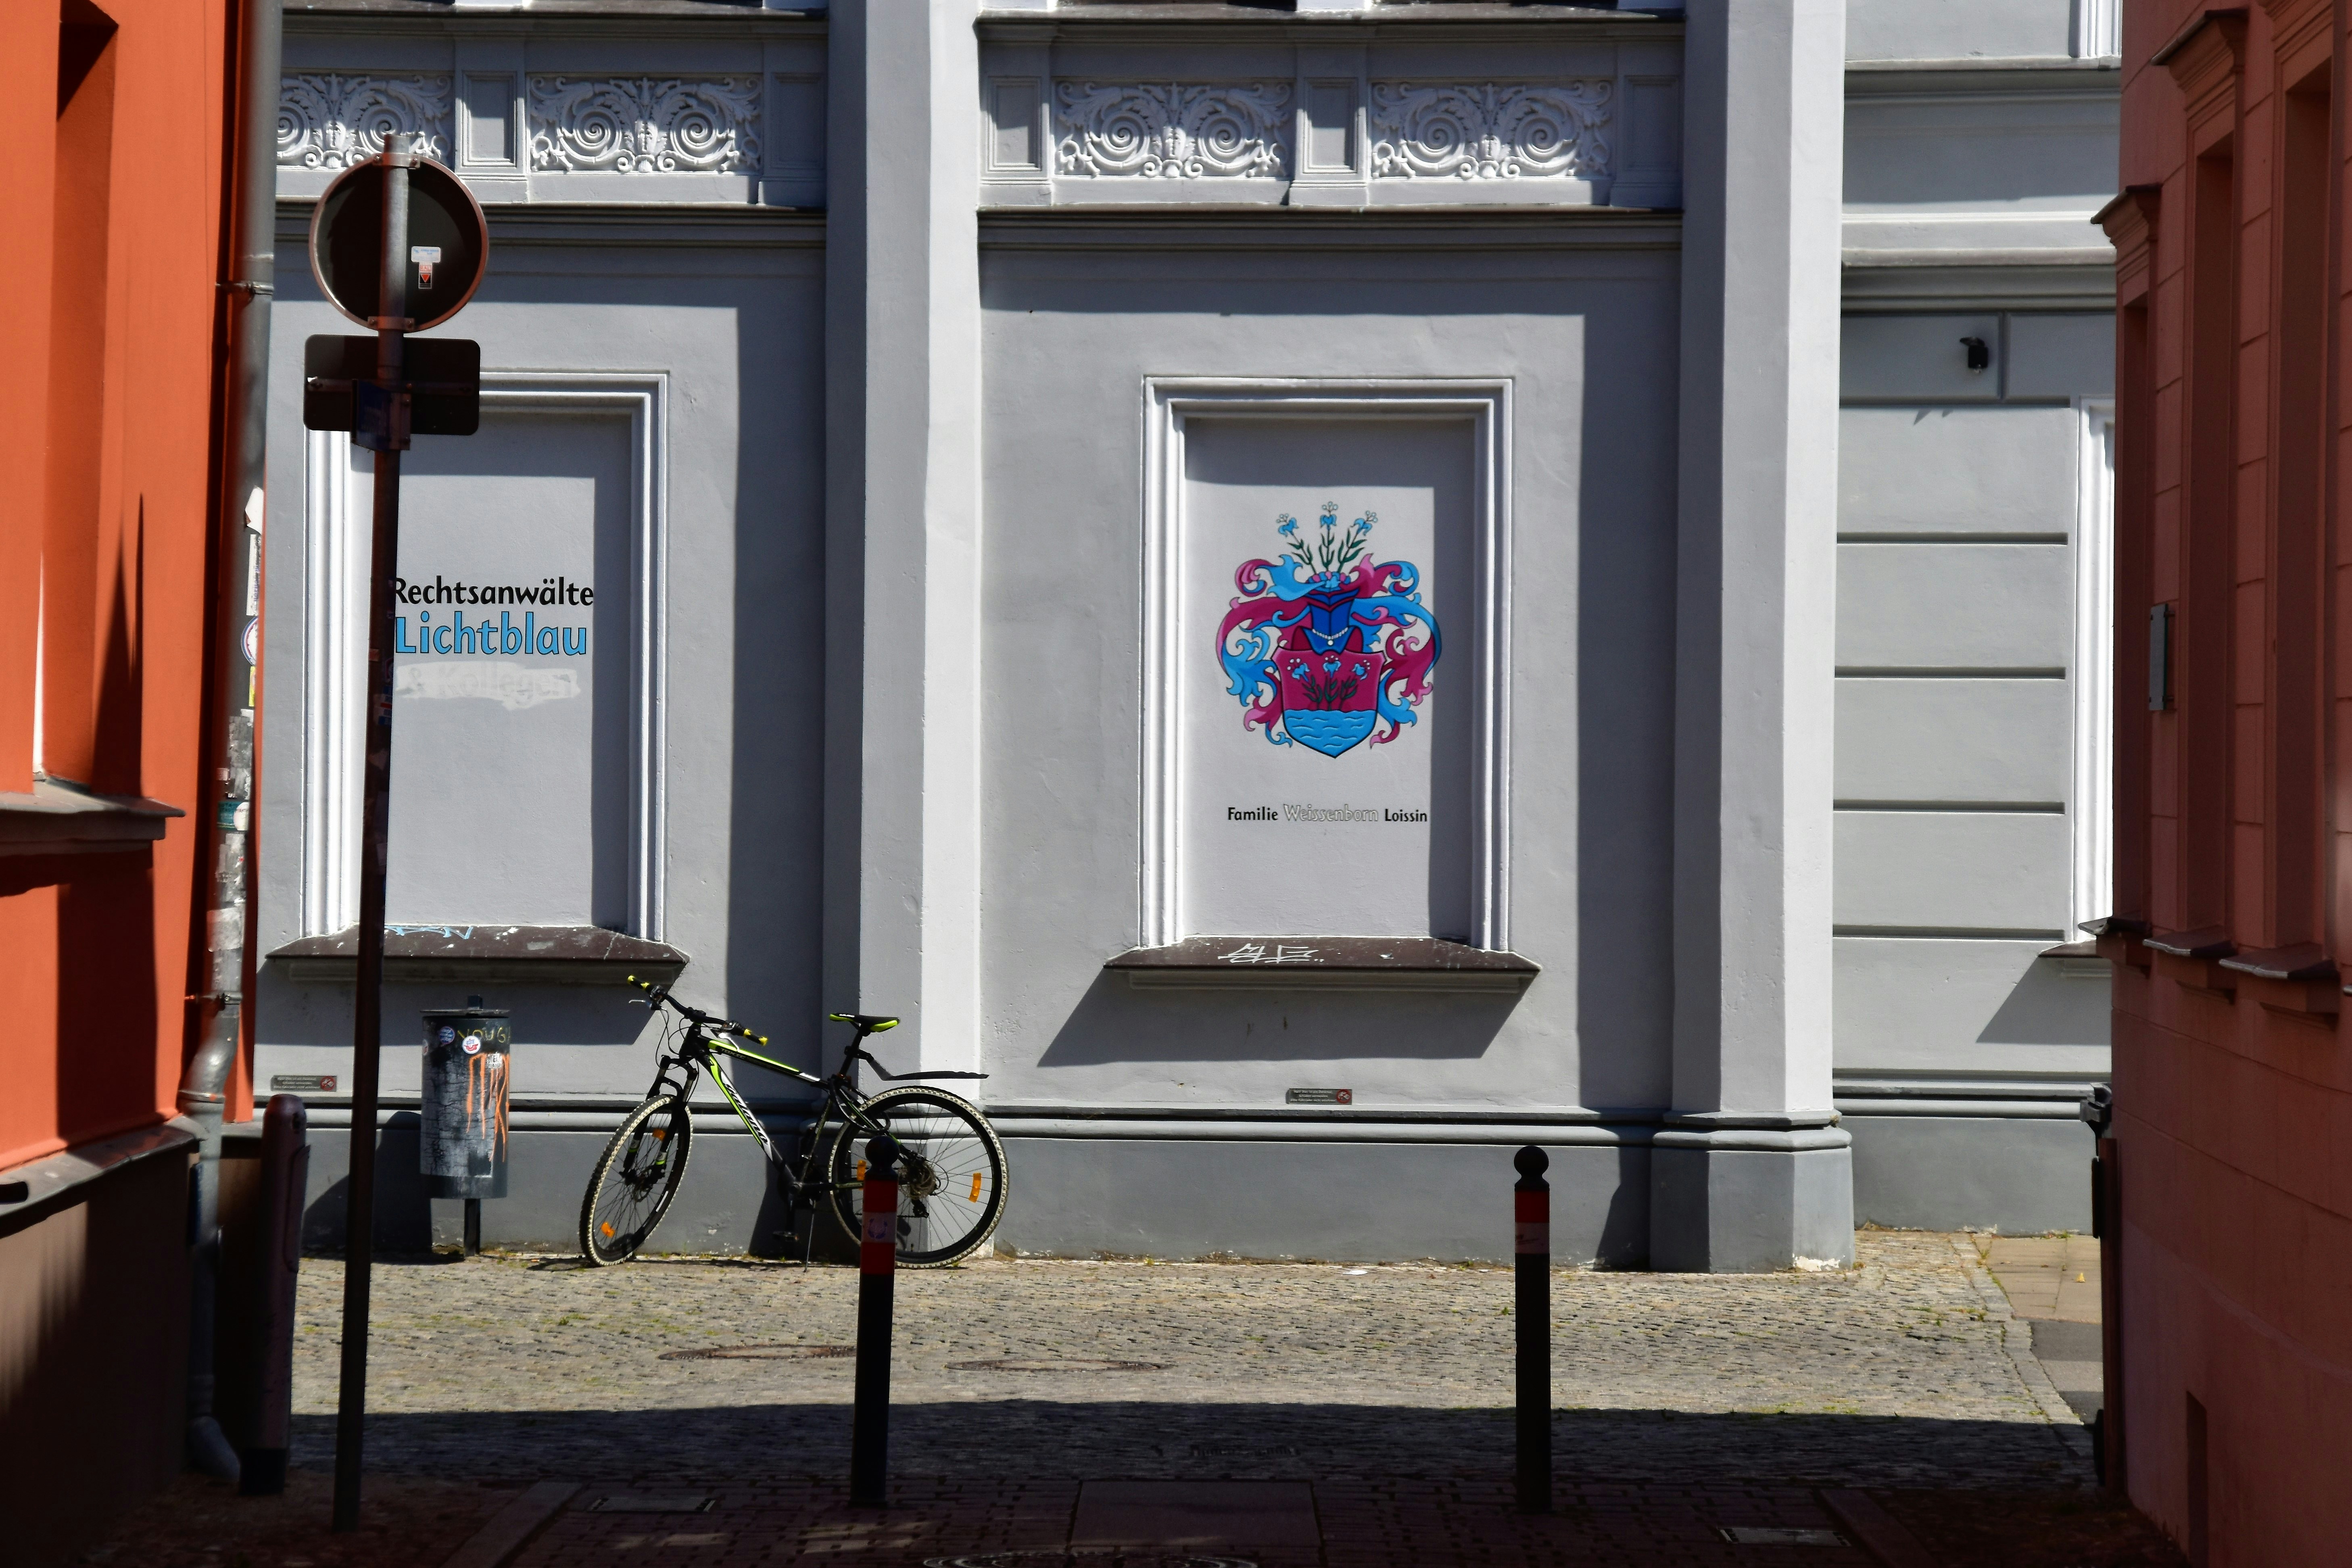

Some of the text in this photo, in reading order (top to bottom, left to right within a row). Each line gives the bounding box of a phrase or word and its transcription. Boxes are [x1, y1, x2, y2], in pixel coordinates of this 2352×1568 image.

[395, 575, 594, 605] Rechtsanwälte
[395, 610, 587, 656] Lichtblau
[1228, 804, 1428, 823] Familie Weissenborn Loissin
